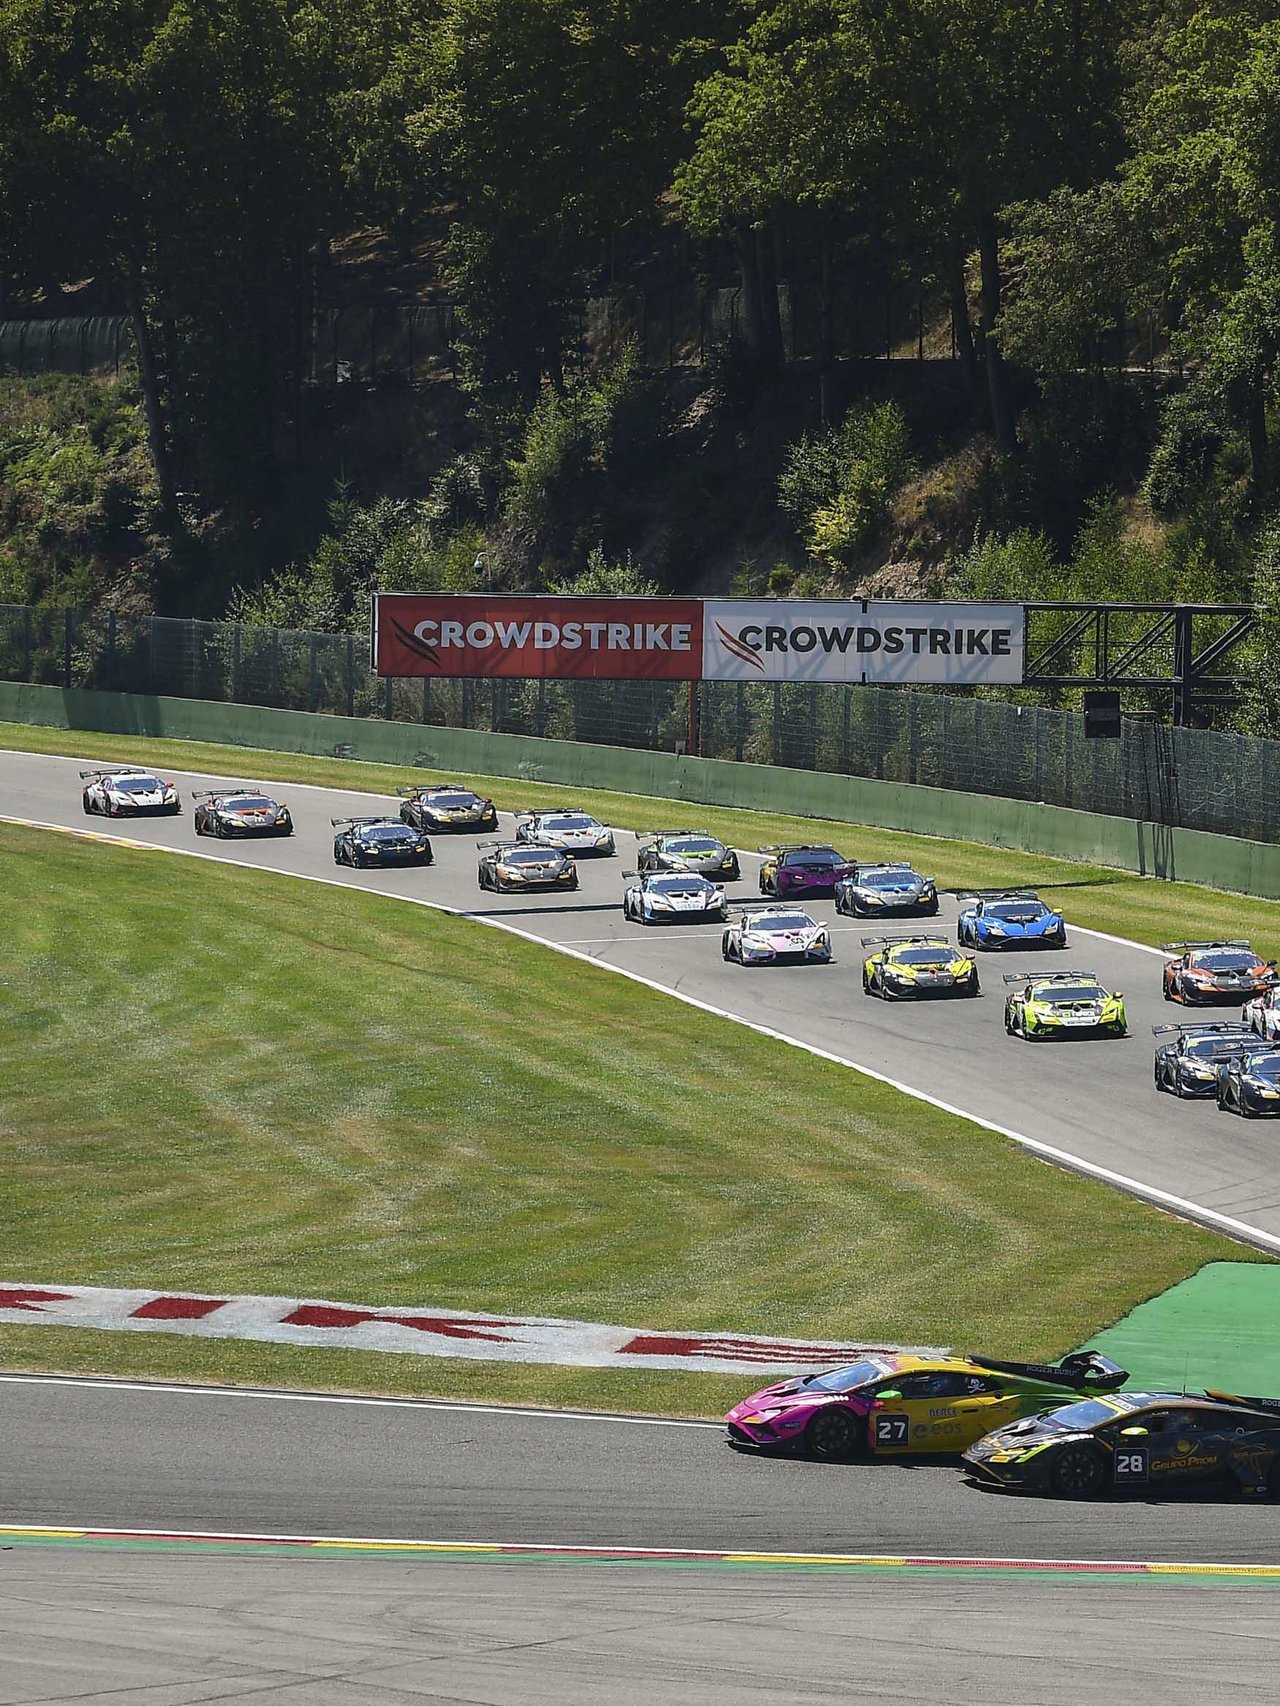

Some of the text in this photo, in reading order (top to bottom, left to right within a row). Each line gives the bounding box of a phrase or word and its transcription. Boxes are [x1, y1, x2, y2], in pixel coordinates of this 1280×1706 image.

[413, 619, 692, 651] CROWDSTRIKE
[738, 625, 1012, 655] CROWDSTRIKE
[878, 1421, 906, 1440] 27
[1117, 1455, 1143, 1473] 28
